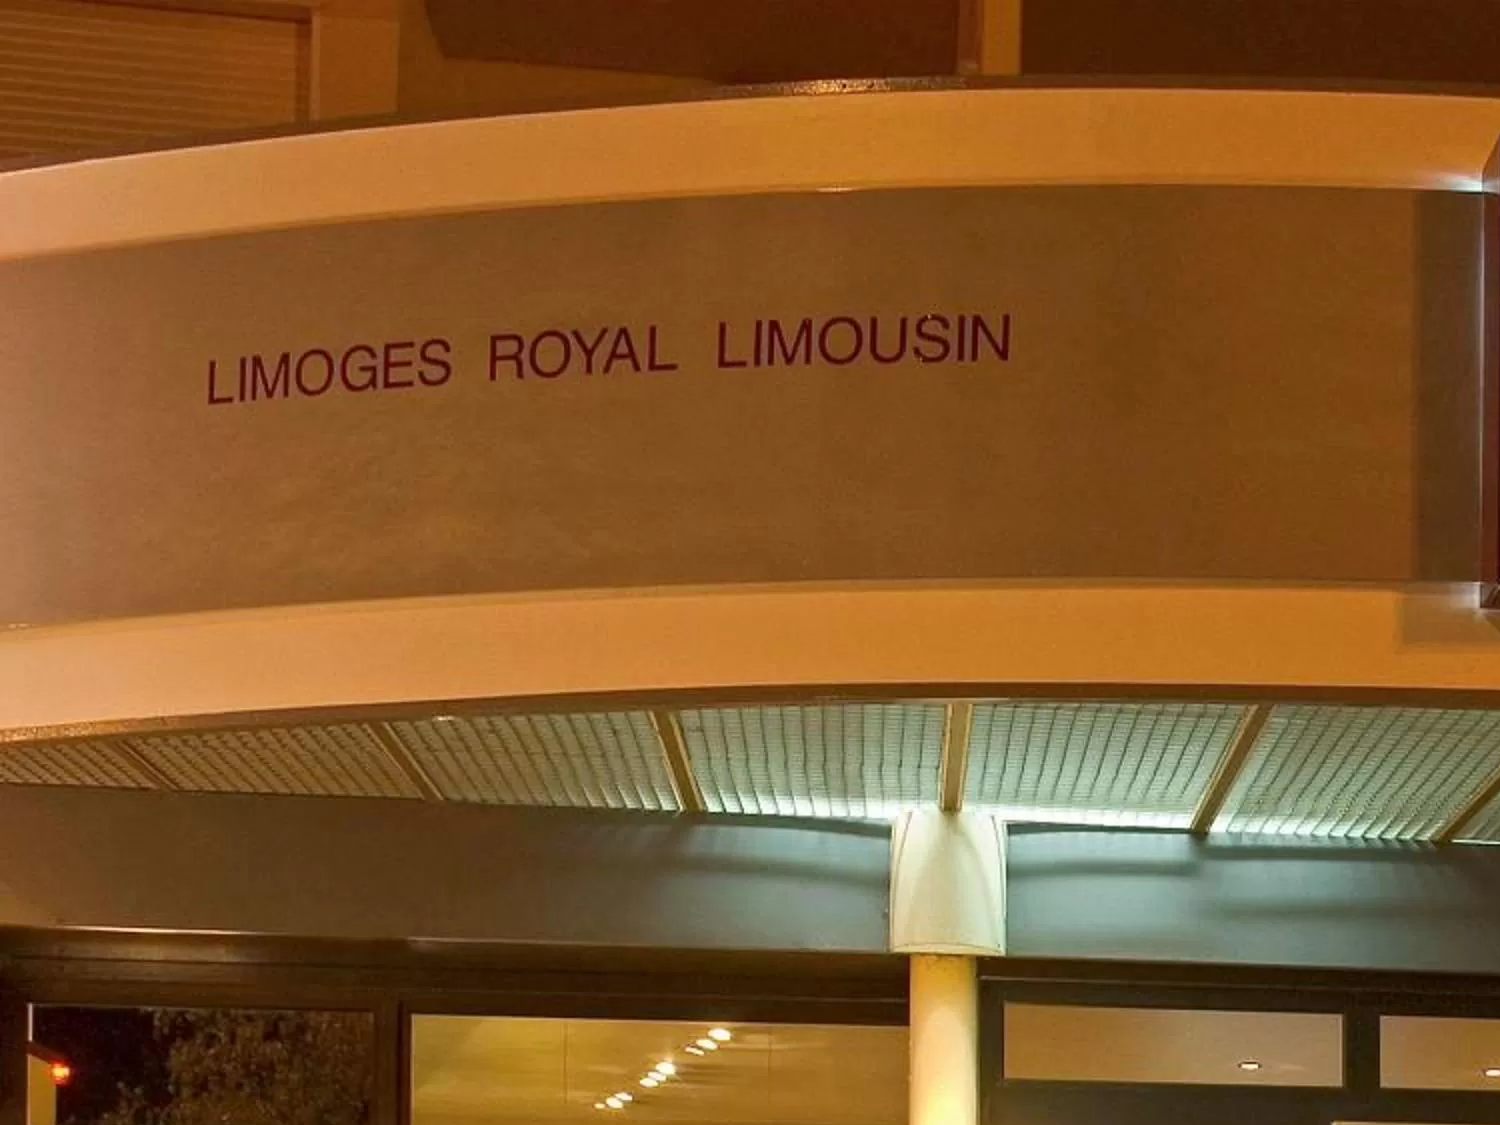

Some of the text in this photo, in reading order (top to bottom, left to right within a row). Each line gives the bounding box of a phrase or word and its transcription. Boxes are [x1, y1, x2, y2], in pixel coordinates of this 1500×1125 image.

[207, 313, 1012, 406] LIMOGES ROYAL LIMOUSIN
